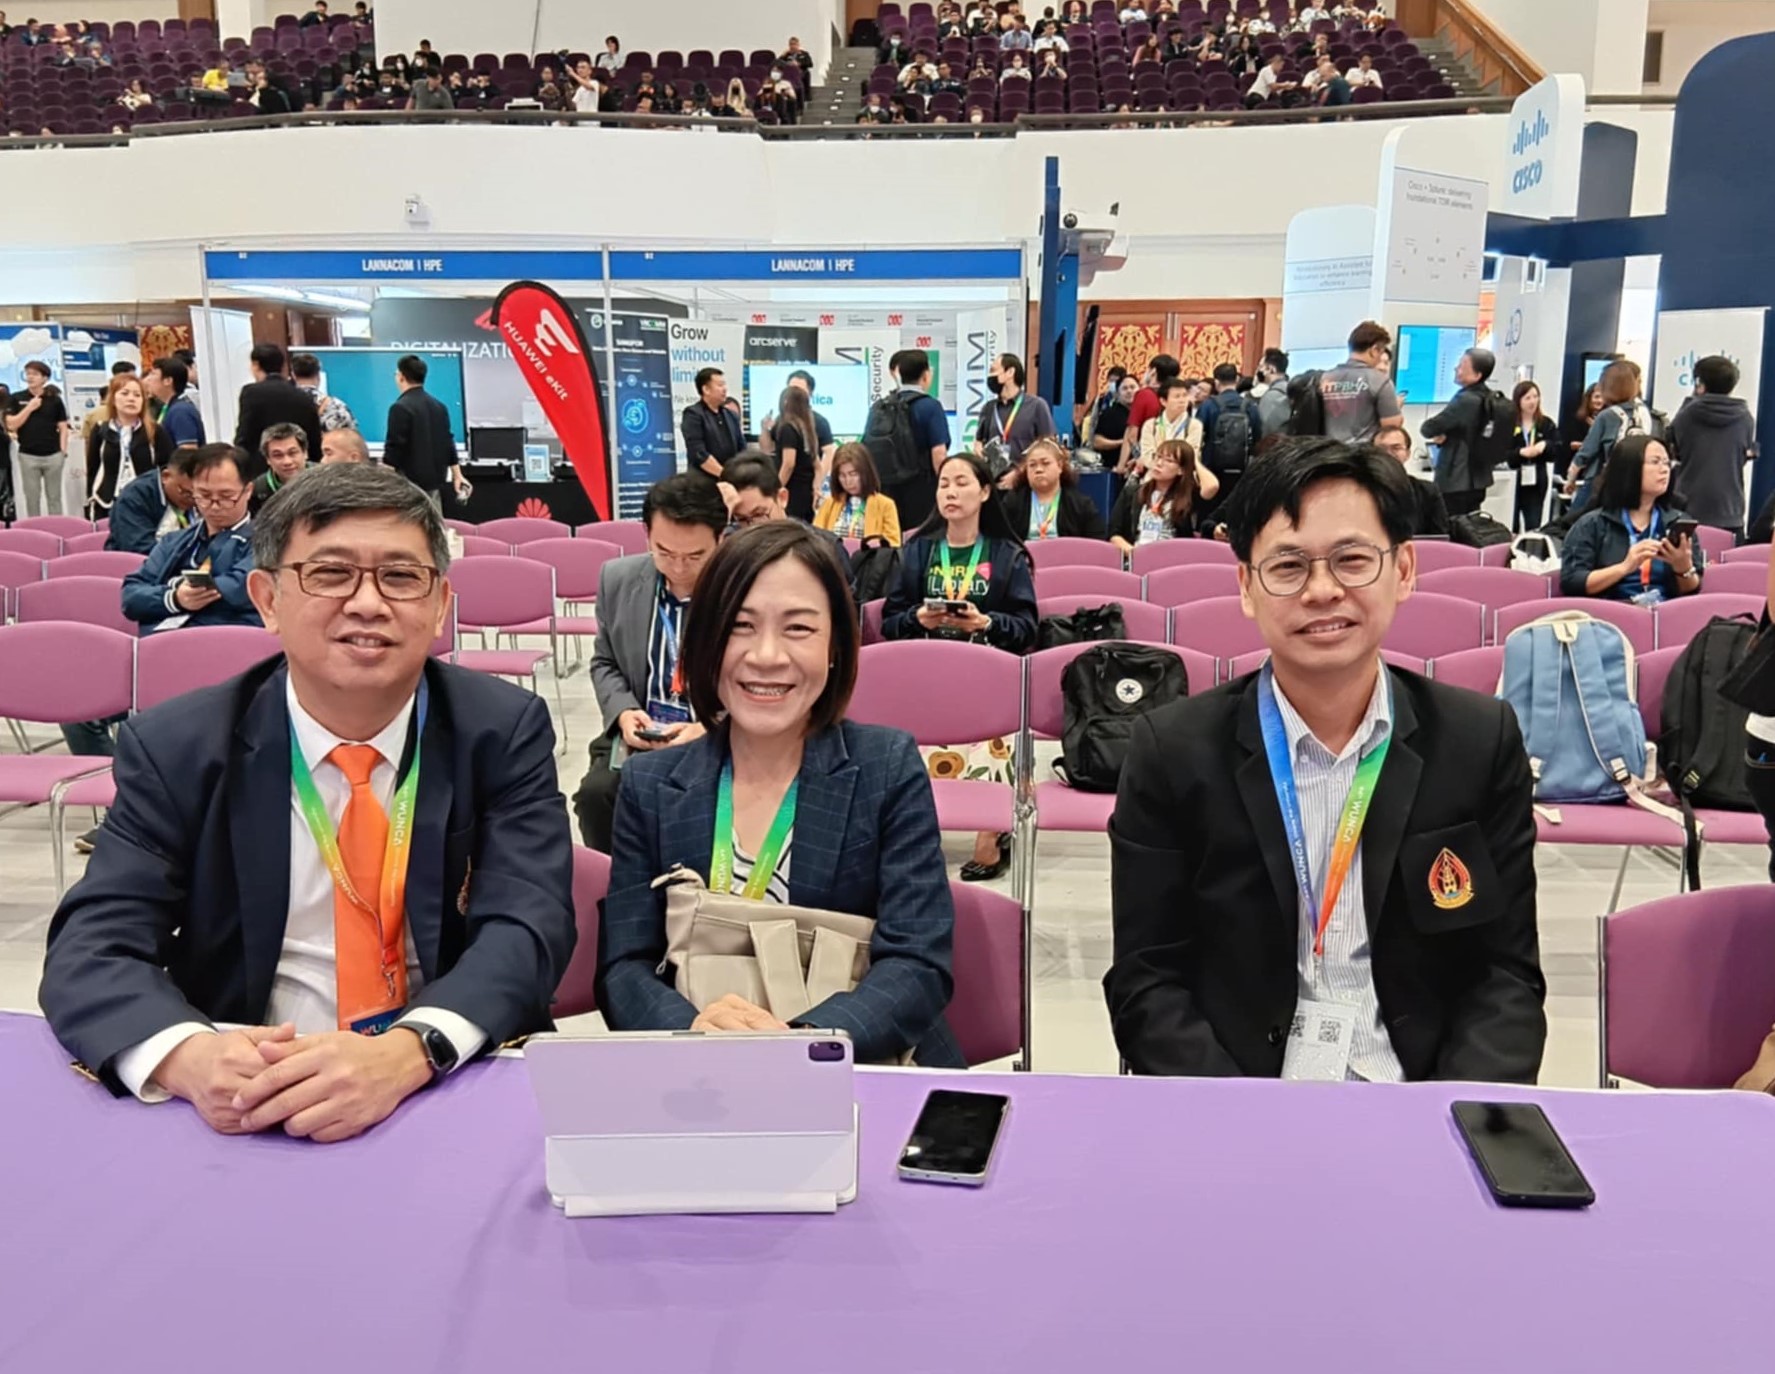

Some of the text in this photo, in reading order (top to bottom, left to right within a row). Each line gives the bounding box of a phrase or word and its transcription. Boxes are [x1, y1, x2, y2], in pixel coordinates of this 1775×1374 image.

[362, 258, 415, 272] LANNACOM
[423, 259, 444, 272] HPE
[771, 258, 826, 272] LANNACOM
[835, 259, 855, 272] HPE
[671, 323, 708, 340] Grow
[749, 336, 798, 348] arcserve
[504, 321, 568, 401] HUAWEI eKit
[671, 345, 725, 362] without
[871, 346, 884, 402] Security
[392, 800, 409, 847] WUNCA
[1341, 800, 1363, 844] WUNCA
[1294, 838, 1308, 884] WUNCA
